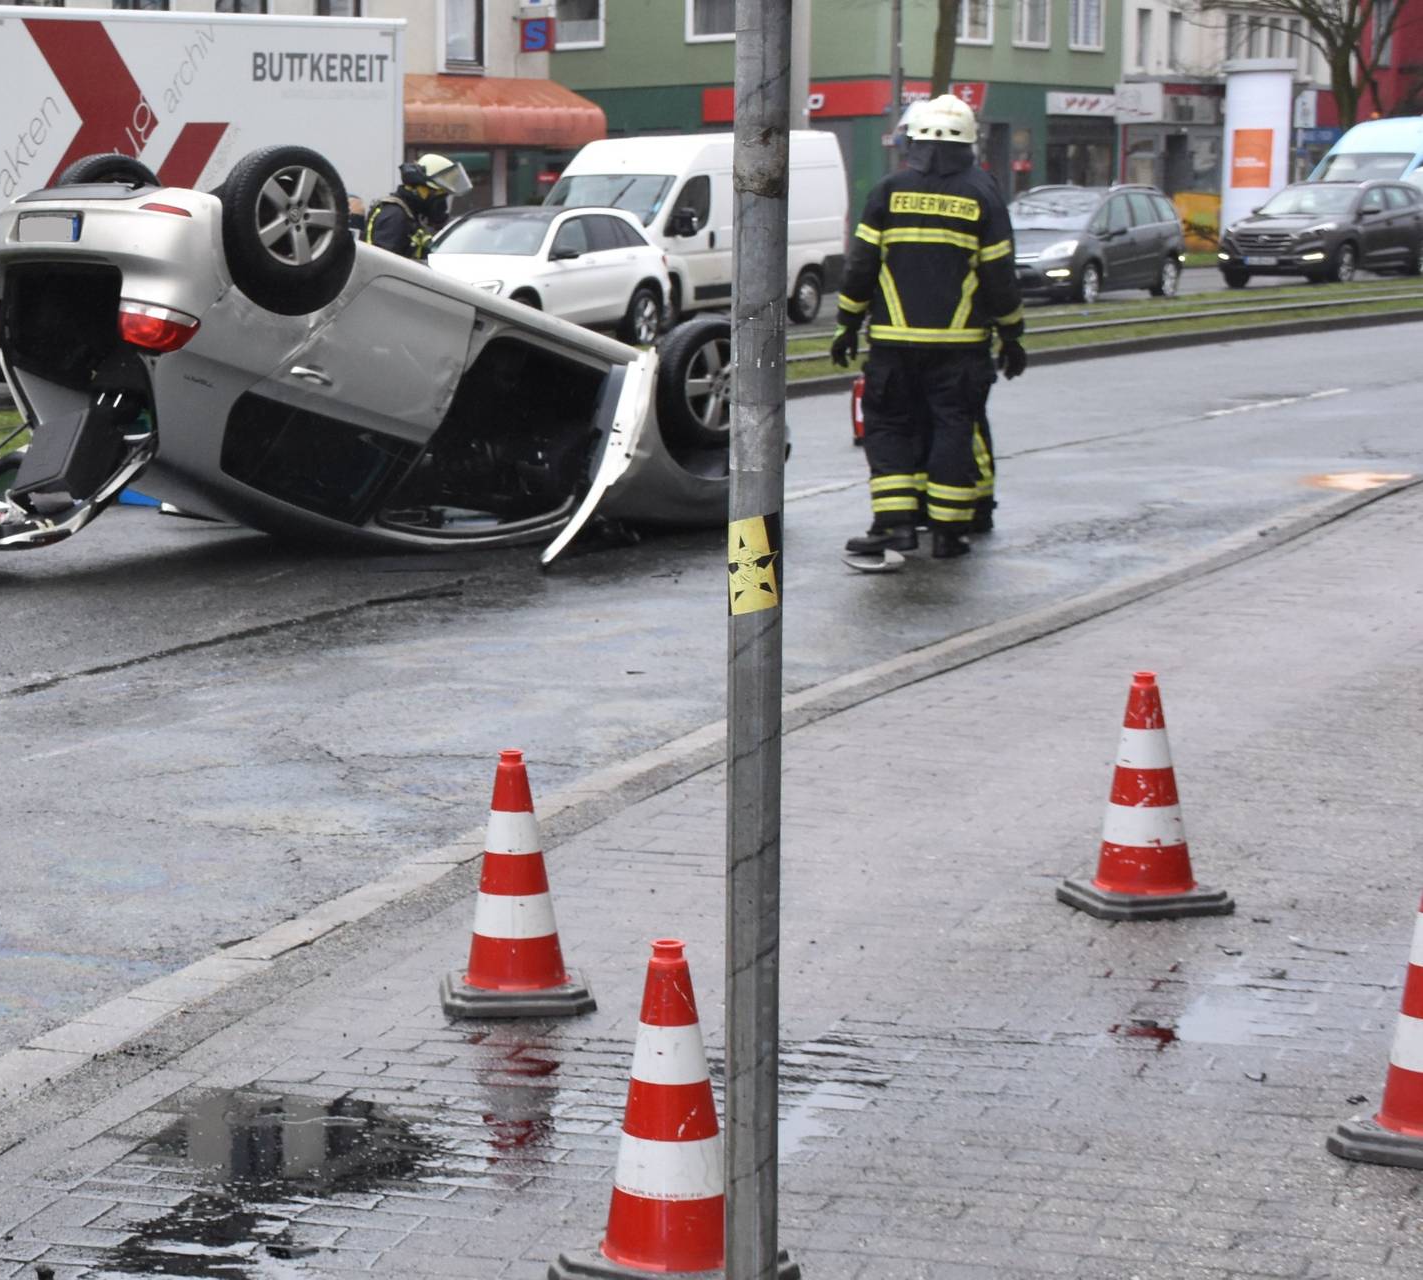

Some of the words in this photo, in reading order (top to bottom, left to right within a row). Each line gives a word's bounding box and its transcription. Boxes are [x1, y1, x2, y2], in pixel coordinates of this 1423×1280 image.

[525, 21, 547, 48] S
[163, 24, 216, 114] archiv
[252, 52, 389, 82] BUTTKEREIT
[895, 195, 977, 217] FEUERWEHR
